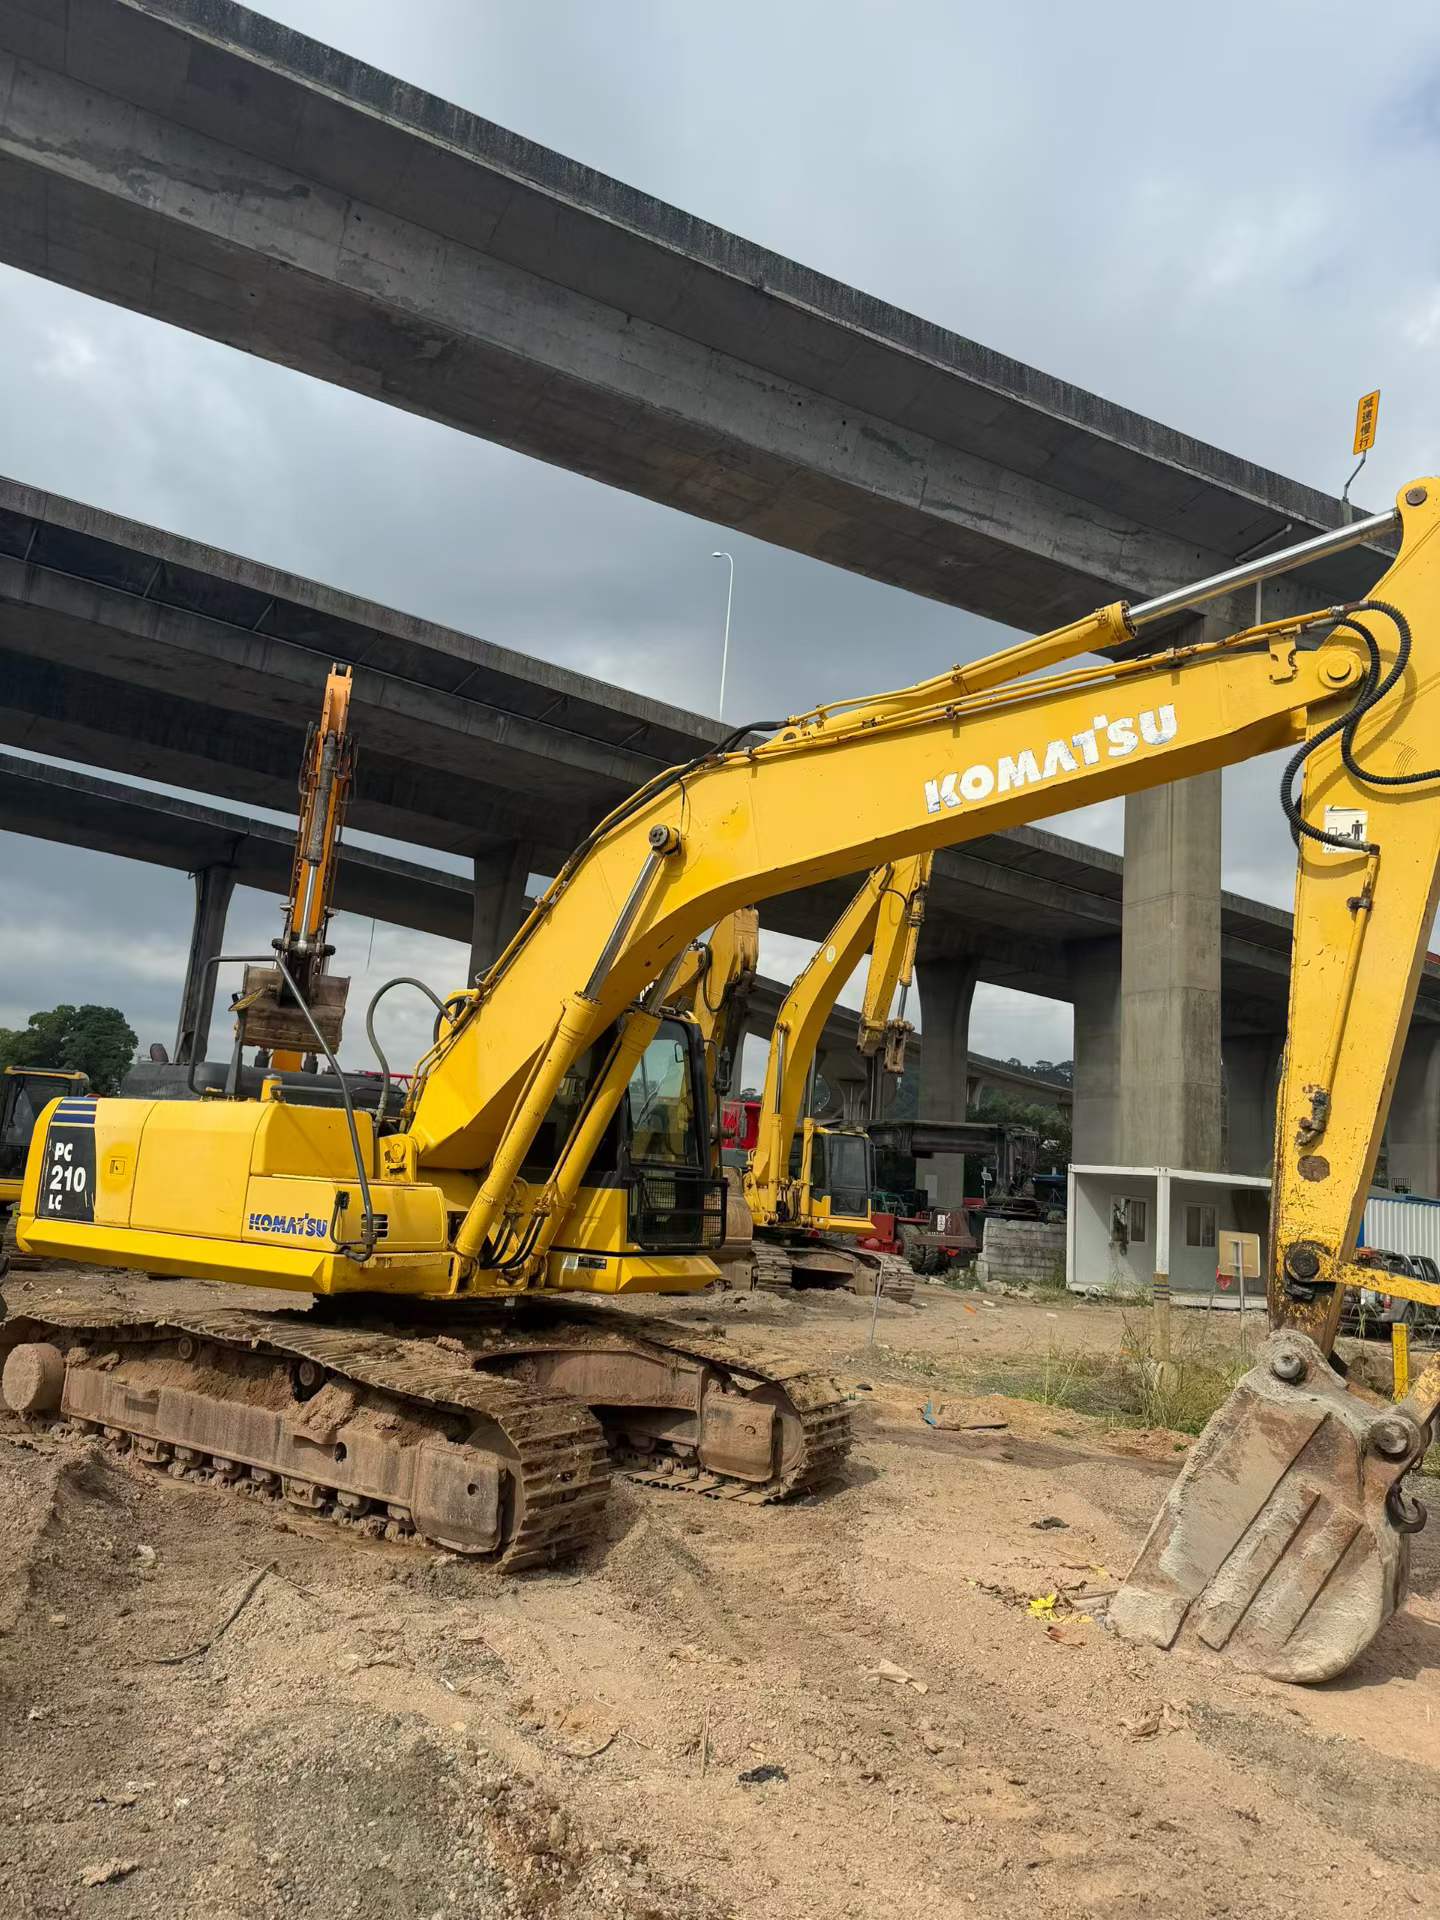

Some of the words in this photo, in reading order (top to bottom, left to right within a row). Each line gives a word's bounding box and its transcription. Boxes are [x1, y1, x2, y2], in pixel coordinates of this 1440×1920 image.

[924, 703, 1178, 814] KOMATSU
[54, 1142, 73, 1162] PC
[49, 1166, 86, 1193] 210
[48, 1193, 62, 1211] LC
[248, 1212, 328, 1238] KOMATSU
